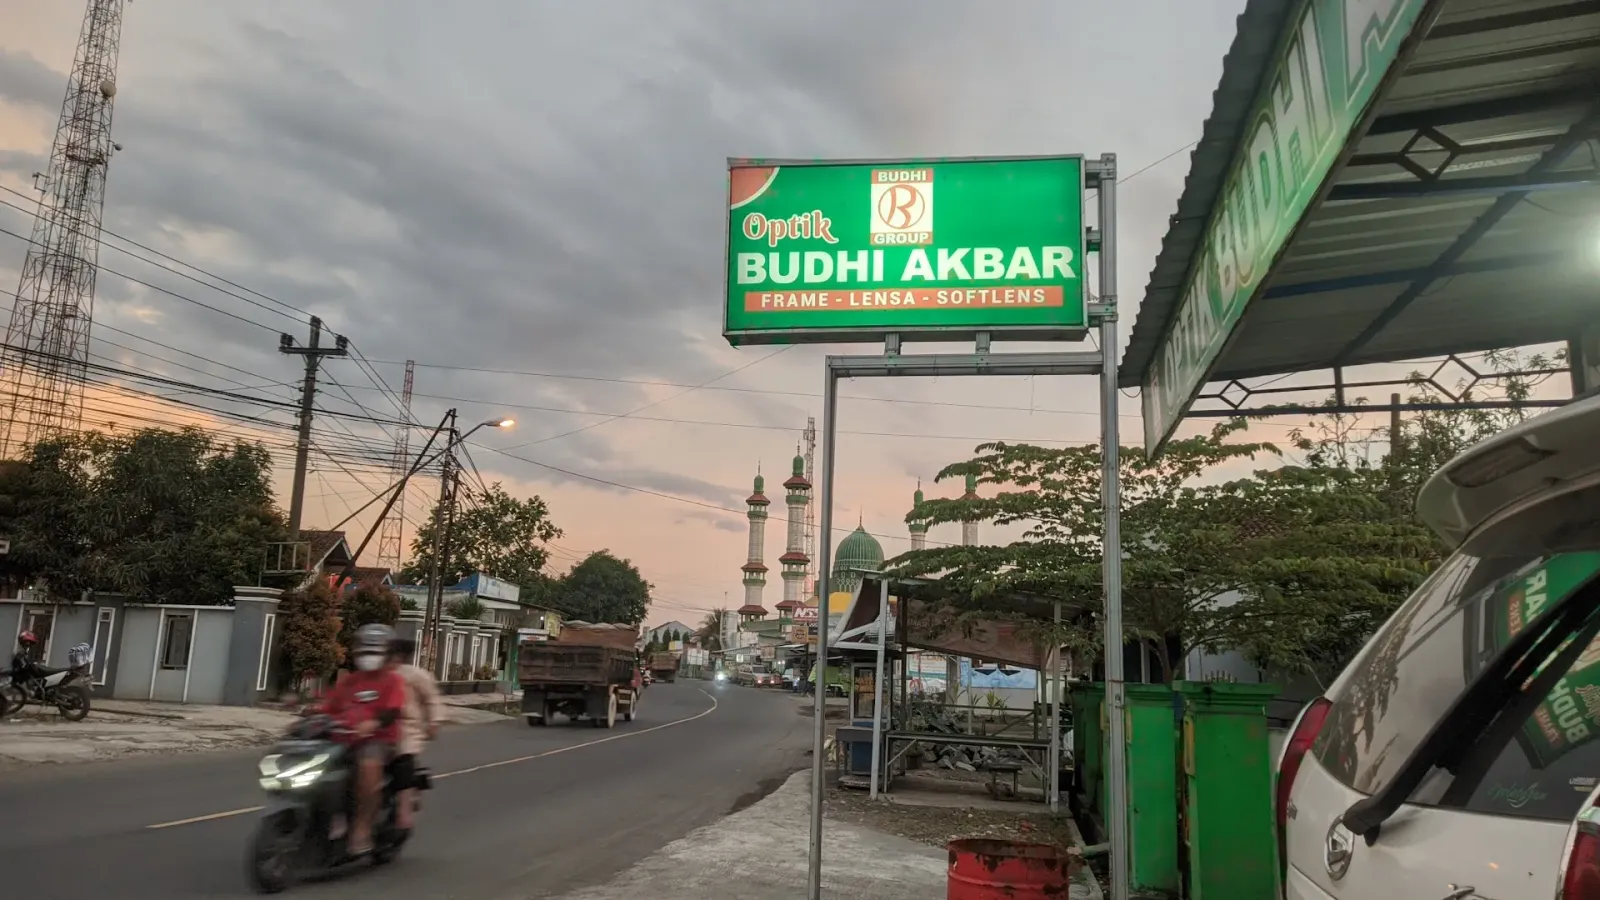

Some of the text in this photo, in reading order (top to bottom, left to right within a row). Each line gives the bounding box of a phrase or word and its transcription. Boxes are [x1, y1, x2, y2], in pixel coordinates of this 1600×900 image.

[878, 171, 926, 182] BUDHI
[1164, 4, 1332, 412] OPTIK BUDHI
[742, 209, 839, 247] Optik
[874, 232, 929, 245] GROUP
[737, 246, 1076, 284] BUDHI AKBAR
[761, 292, 829, 308] FRAME
[850, 290, 915, 306] LENSA
[937, 288, 1046, 305] SOFTLENS
